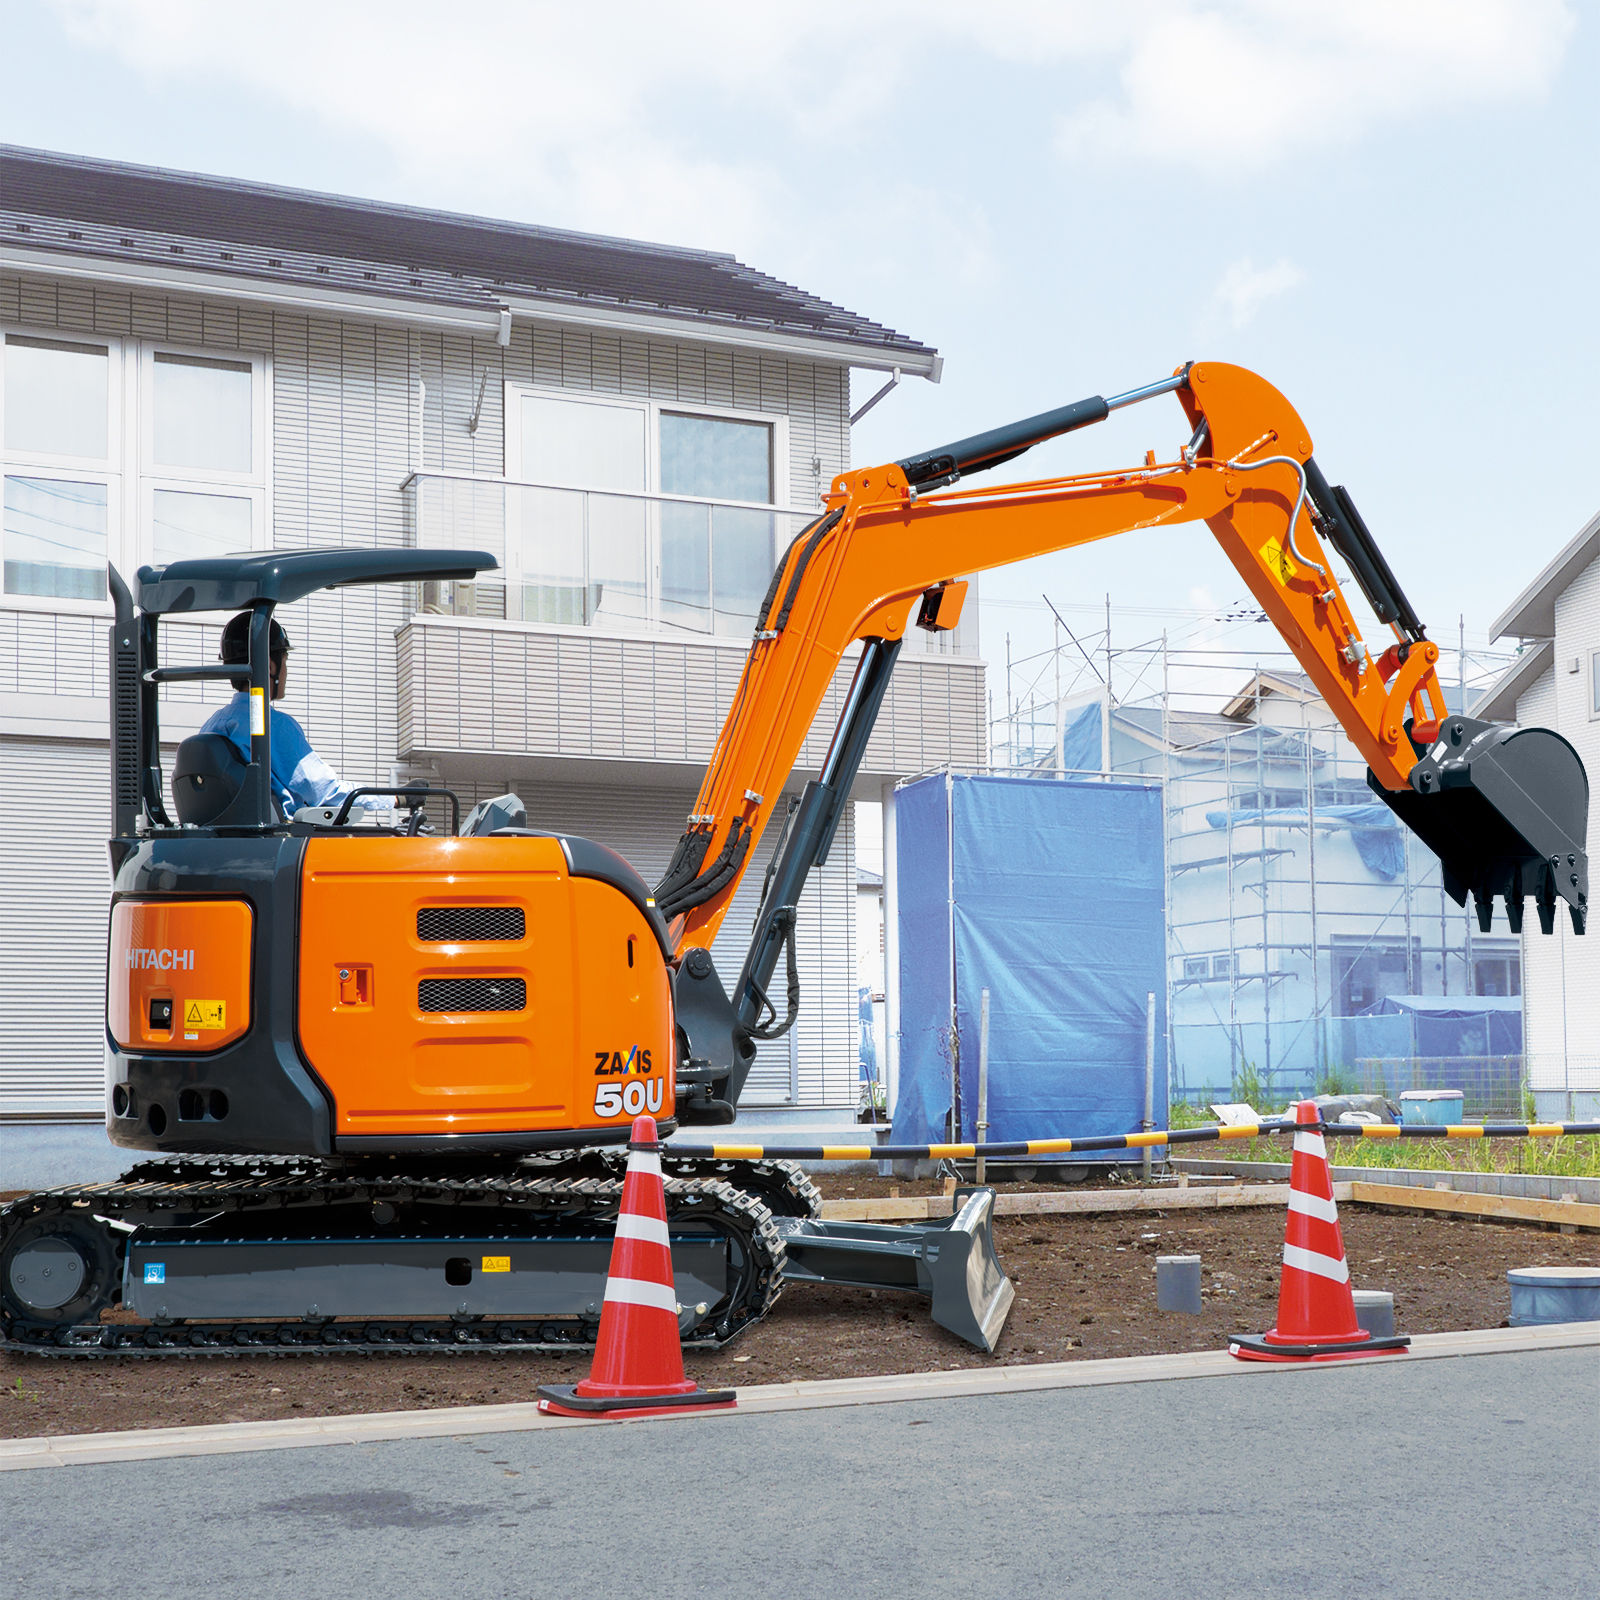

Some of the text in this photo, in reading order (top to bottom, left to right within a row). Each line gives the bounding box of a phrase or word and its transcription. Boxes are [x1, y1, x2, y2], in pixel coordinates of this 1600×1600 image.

[124, 948, 195, 970] HITACHI
[595, 1045, 652, 1075] ZAXIS
[594, 1077, 664, 1118] 50U
